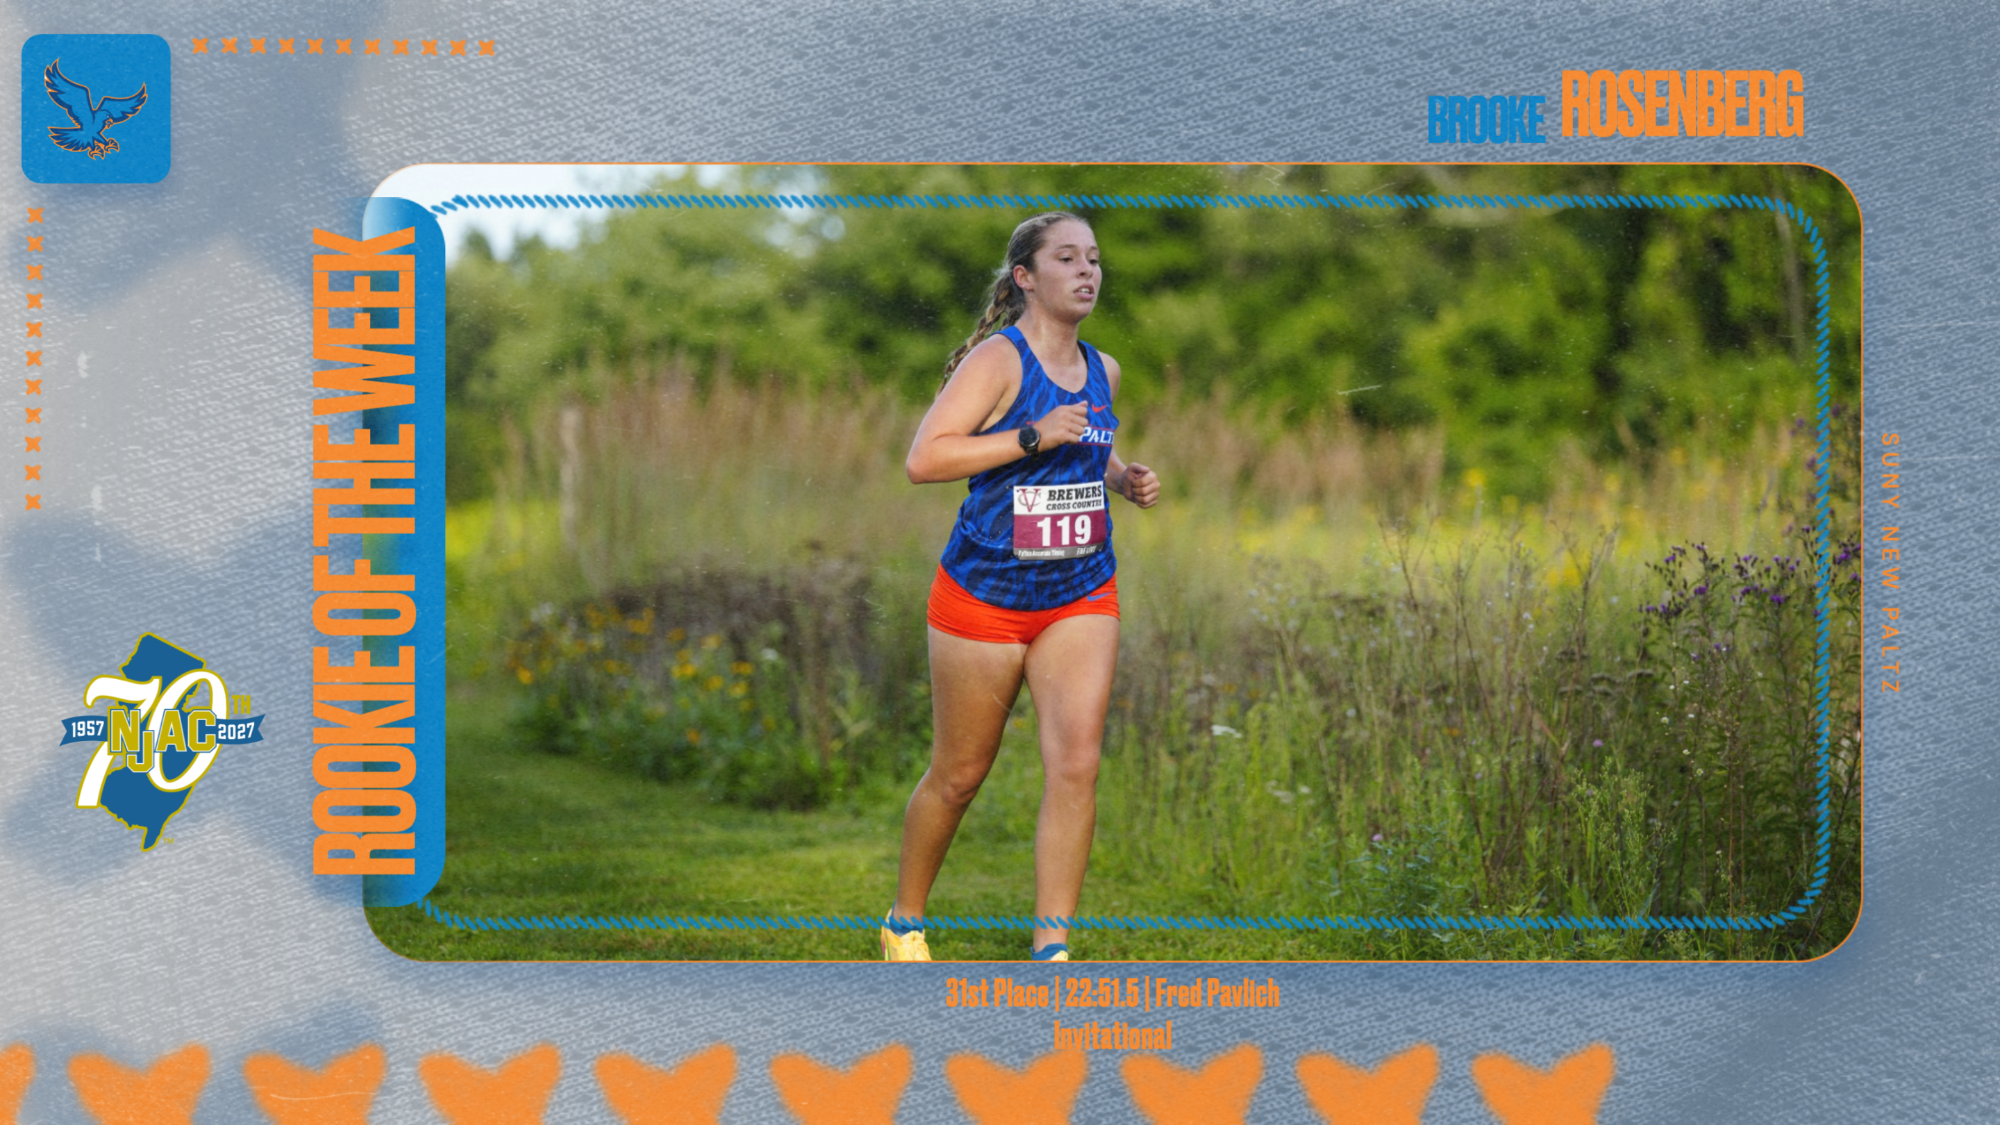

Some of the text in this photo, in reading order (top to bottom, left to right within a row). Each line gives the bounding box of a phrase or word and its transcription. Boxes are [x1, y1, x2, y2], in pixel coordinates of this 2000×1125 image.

[1079, 426, 1115, 445] PALT
[1047, 485, 1102, 501] BREWERS
[1046, 502, 1071, 511] CROSS
[1037, 514, 1091, 547] 119
